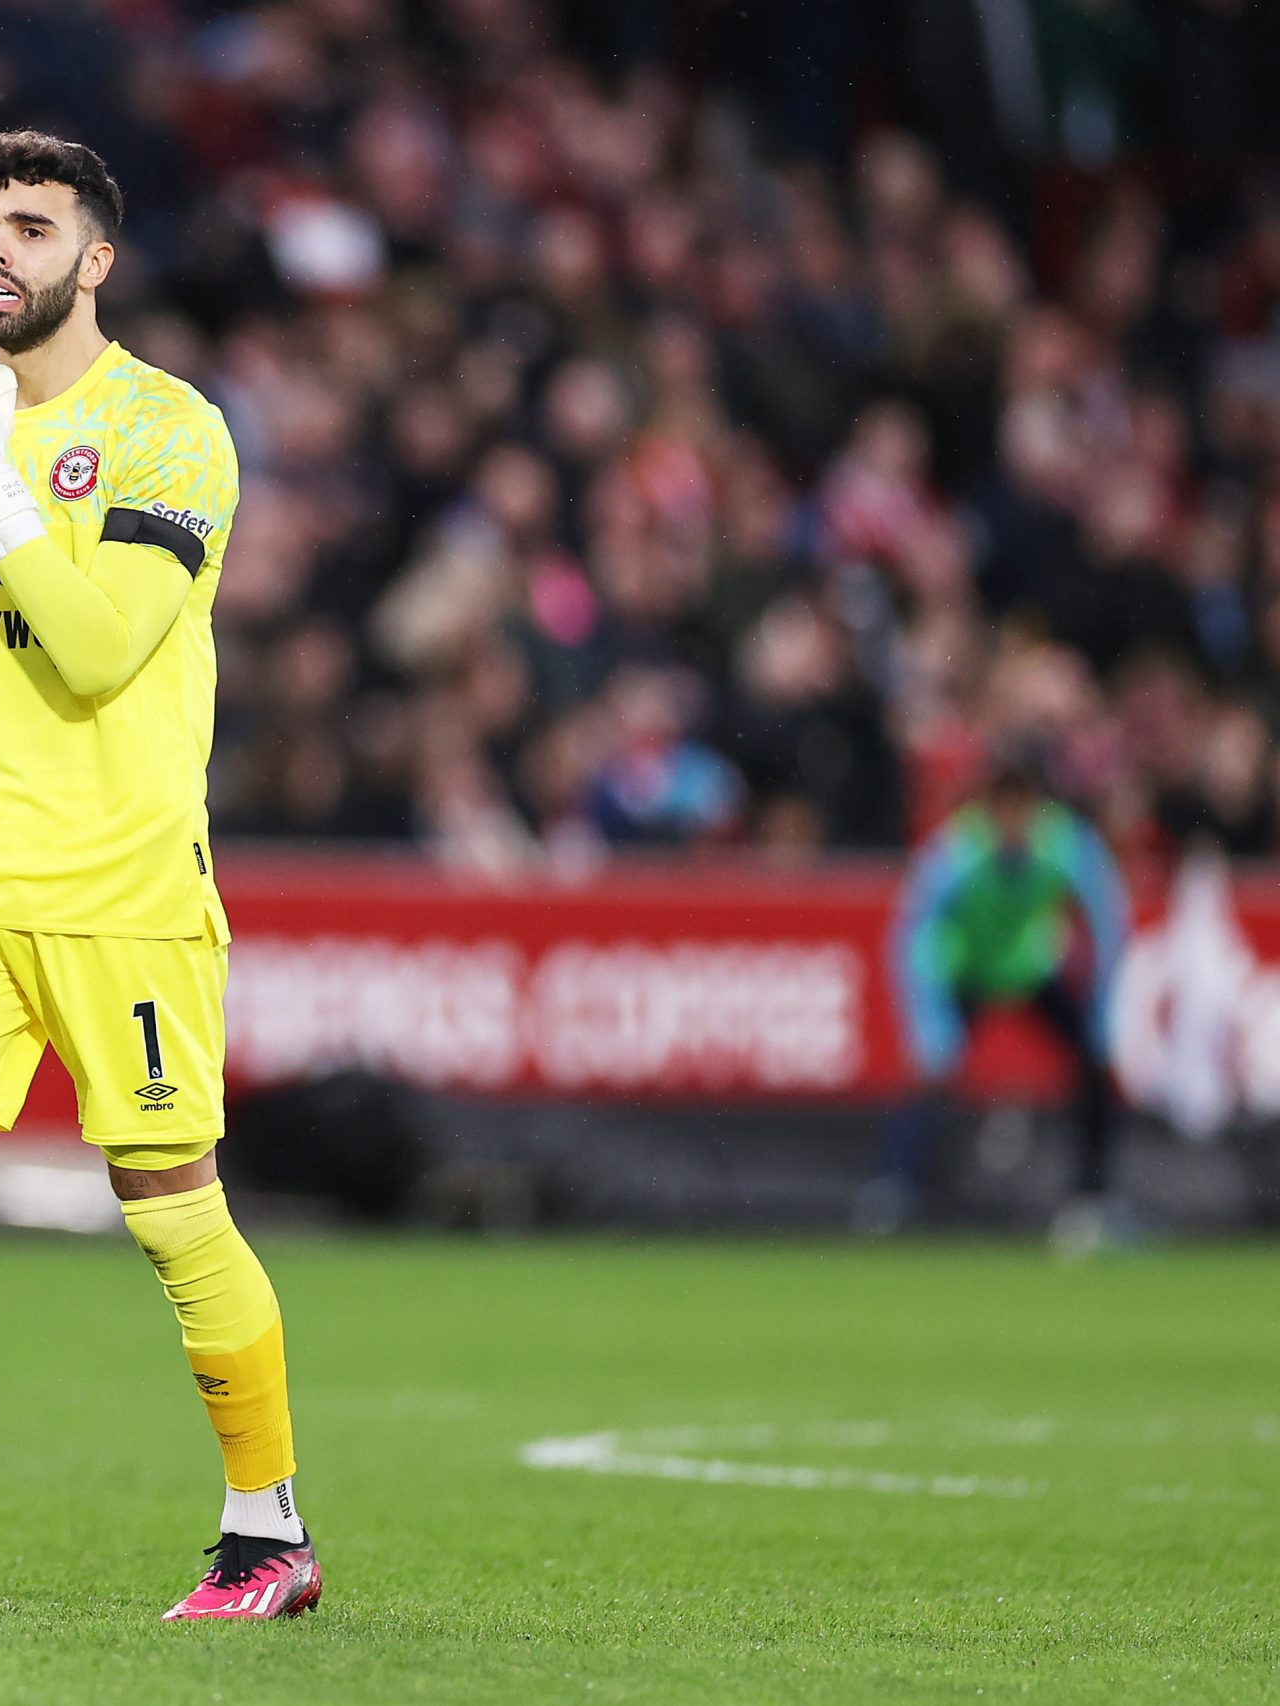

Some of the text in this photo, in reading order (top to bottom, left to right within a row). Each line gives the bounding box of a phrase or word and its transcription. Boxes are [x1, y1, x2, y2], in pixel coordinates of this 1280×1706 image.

[62, 450, 97, 463] BRENTFORD
[76, 485, 90, 495] CLUB
[151, 502, 214, 541] Safety
[132, 1001, 163, 1080] 1
[140, 1102, 174, 1111] umbro
[276, 1483, 292, 1519] SIGN
